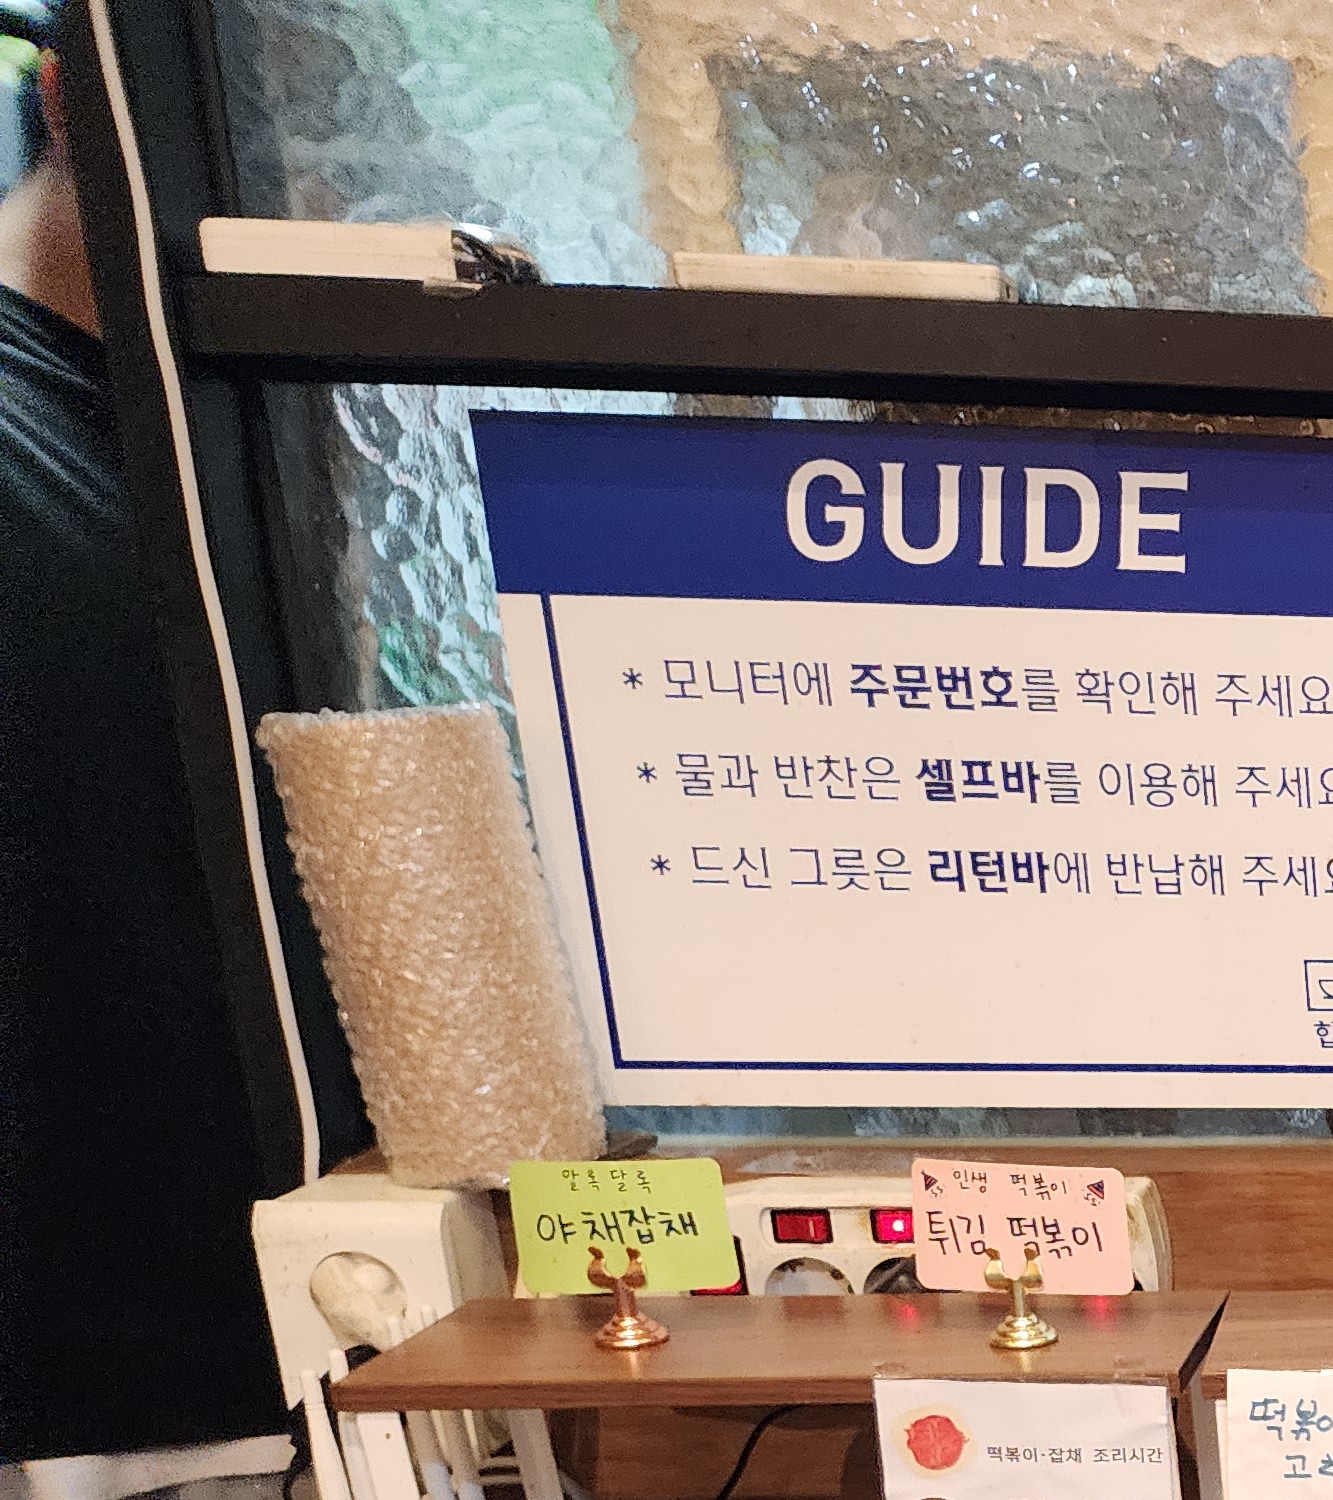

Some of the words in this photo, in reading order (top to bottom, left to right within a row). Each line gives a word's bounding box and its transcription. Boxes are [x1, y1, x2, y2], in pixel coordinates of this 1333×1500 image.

[787, 459, 1188, 573] GUIDE
[664, 660, 832, 706] 모니터에
[851, 664, 1059, 712] 주문번호를
[1076, 668, 1197, 715] 확인해
[676, 754, 758, 797] 물과
[774, 755, 900, 800] 반찬은
[916, 759, 1081, 804] 셀프바를
[1099, 763, 1218, 807] 이용해
[691, 847, 772, 889] 드신
[790, 848, 911, 891] 그릇은
[928, 851, 1090, 894] 리턴바에
[1106, 854, 1225, 895] 반납해
[953, 1169, 987, 1193] 인생
[1009, 1173, 1067, 1200] 떡볶이
[536, 1205, 699, 1245] 야채잡채
[925, 1209, 988, 1257] 튀김
[1006, 1214, 1104, 1260] 떡볶이
[1093, 1448, 1163, 1463] 조리시간
